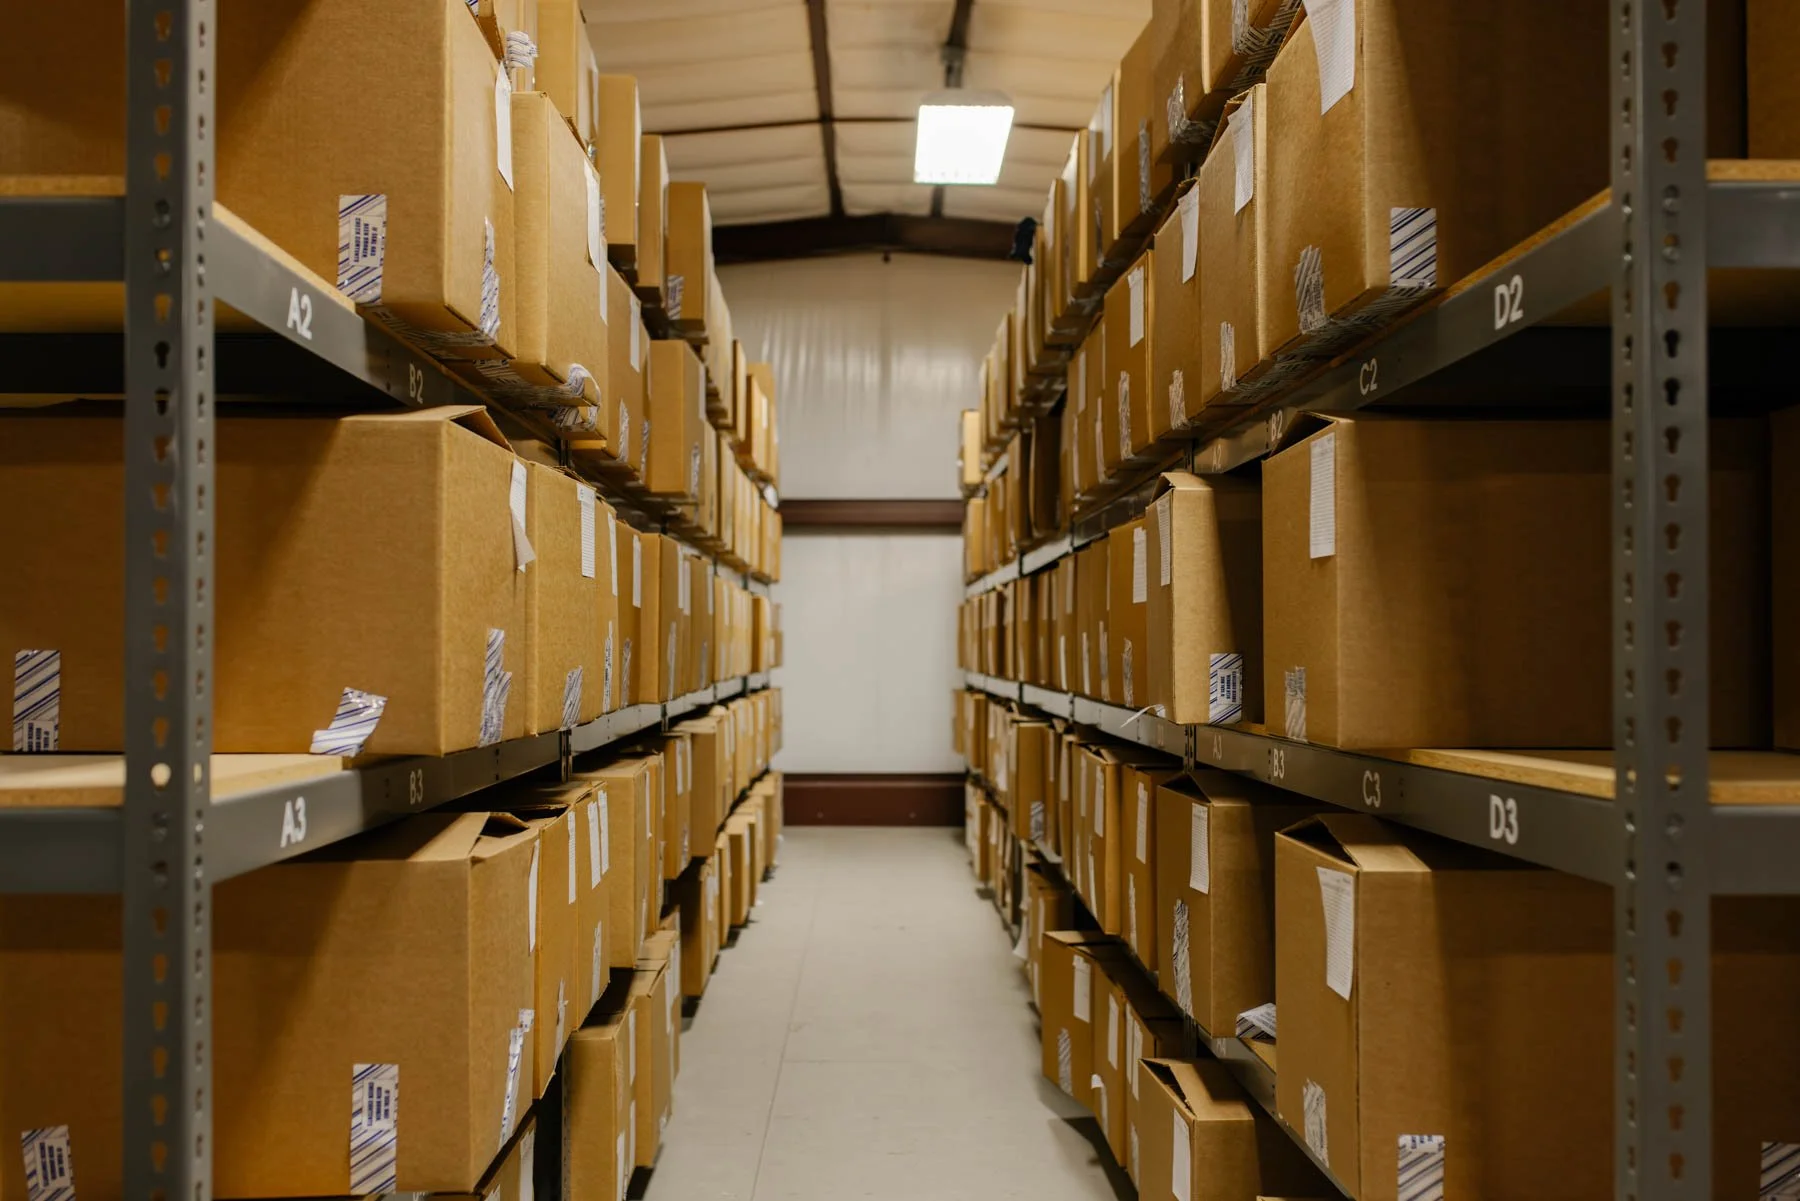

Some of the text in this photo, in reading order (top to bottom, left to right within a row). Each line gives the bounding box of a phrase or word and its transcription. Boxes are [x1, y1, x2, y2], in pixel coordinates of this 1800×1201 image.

[286, 287, 313, 341] A2
[1493, 274, 1524, 332] D2
[409, 362, 424, 404] B2
[1359, 357, 1379, 397] C2
[1270, 409, 1283, 442] B2
[1273, 747, 1286, 780] B3
[409, 767, 424, 806] B3
[1362, 769, 1382, 809] C3
[280, 796, 307, 849] A3
[1489, 793, 1519, 846] D3
